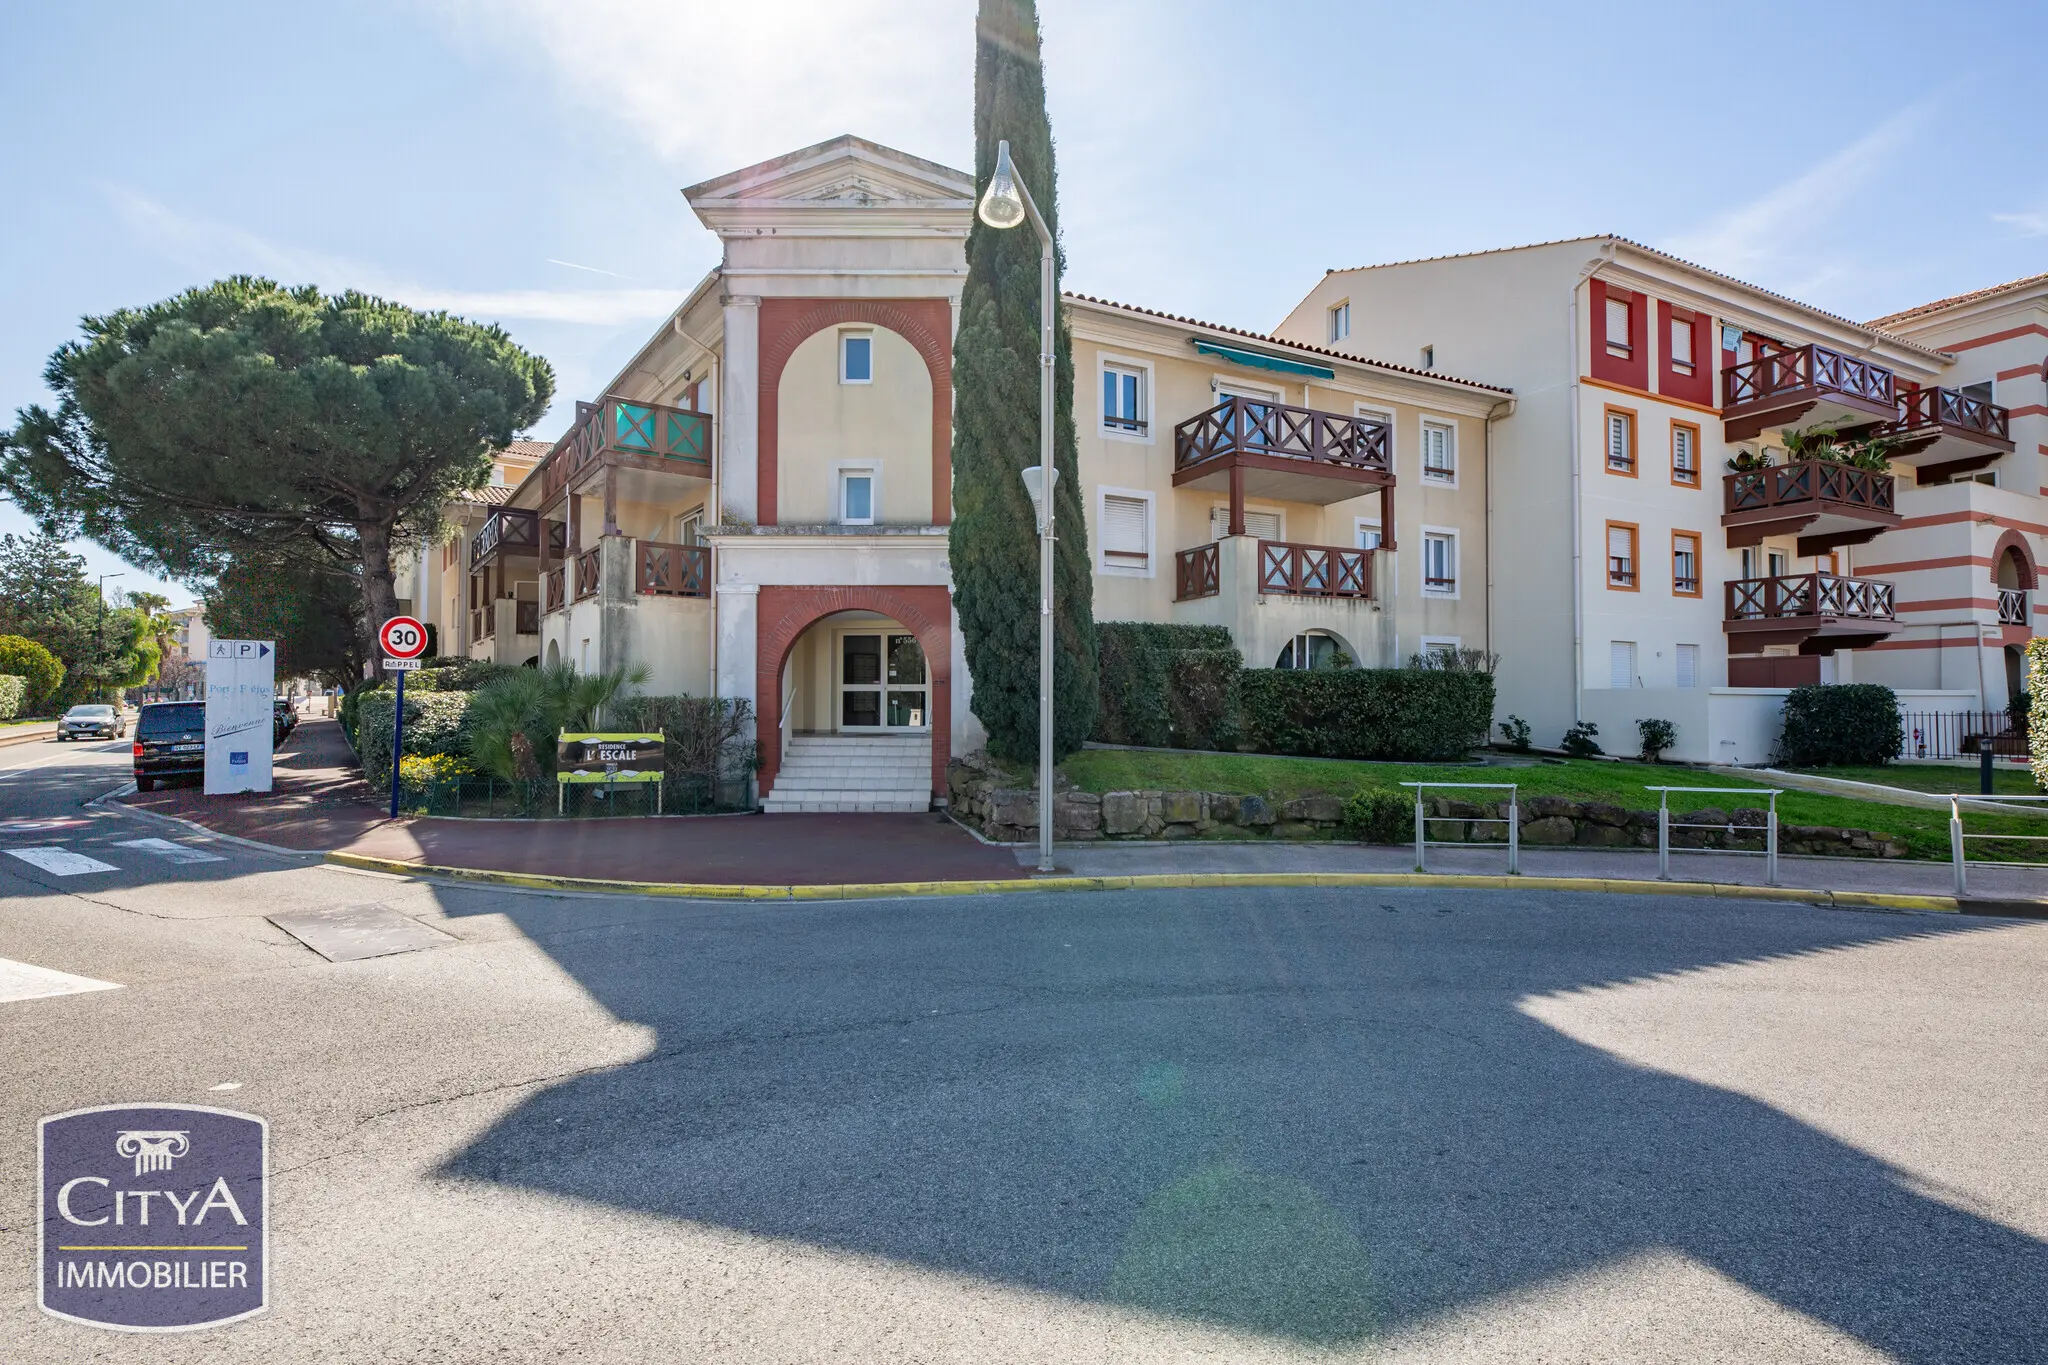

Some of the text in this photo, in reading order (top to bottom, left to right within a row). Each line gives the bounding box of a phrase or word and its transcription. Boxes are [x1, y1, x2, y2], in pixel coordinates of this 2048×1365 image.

[392, 630, 416, 645] 30
[241, 645, 251, 655] P
[210, 684, 270, 694] Port Féjus
[211, 718, 265, 735] Bienvenue
[601, 750, 636, 760] ESCALE
